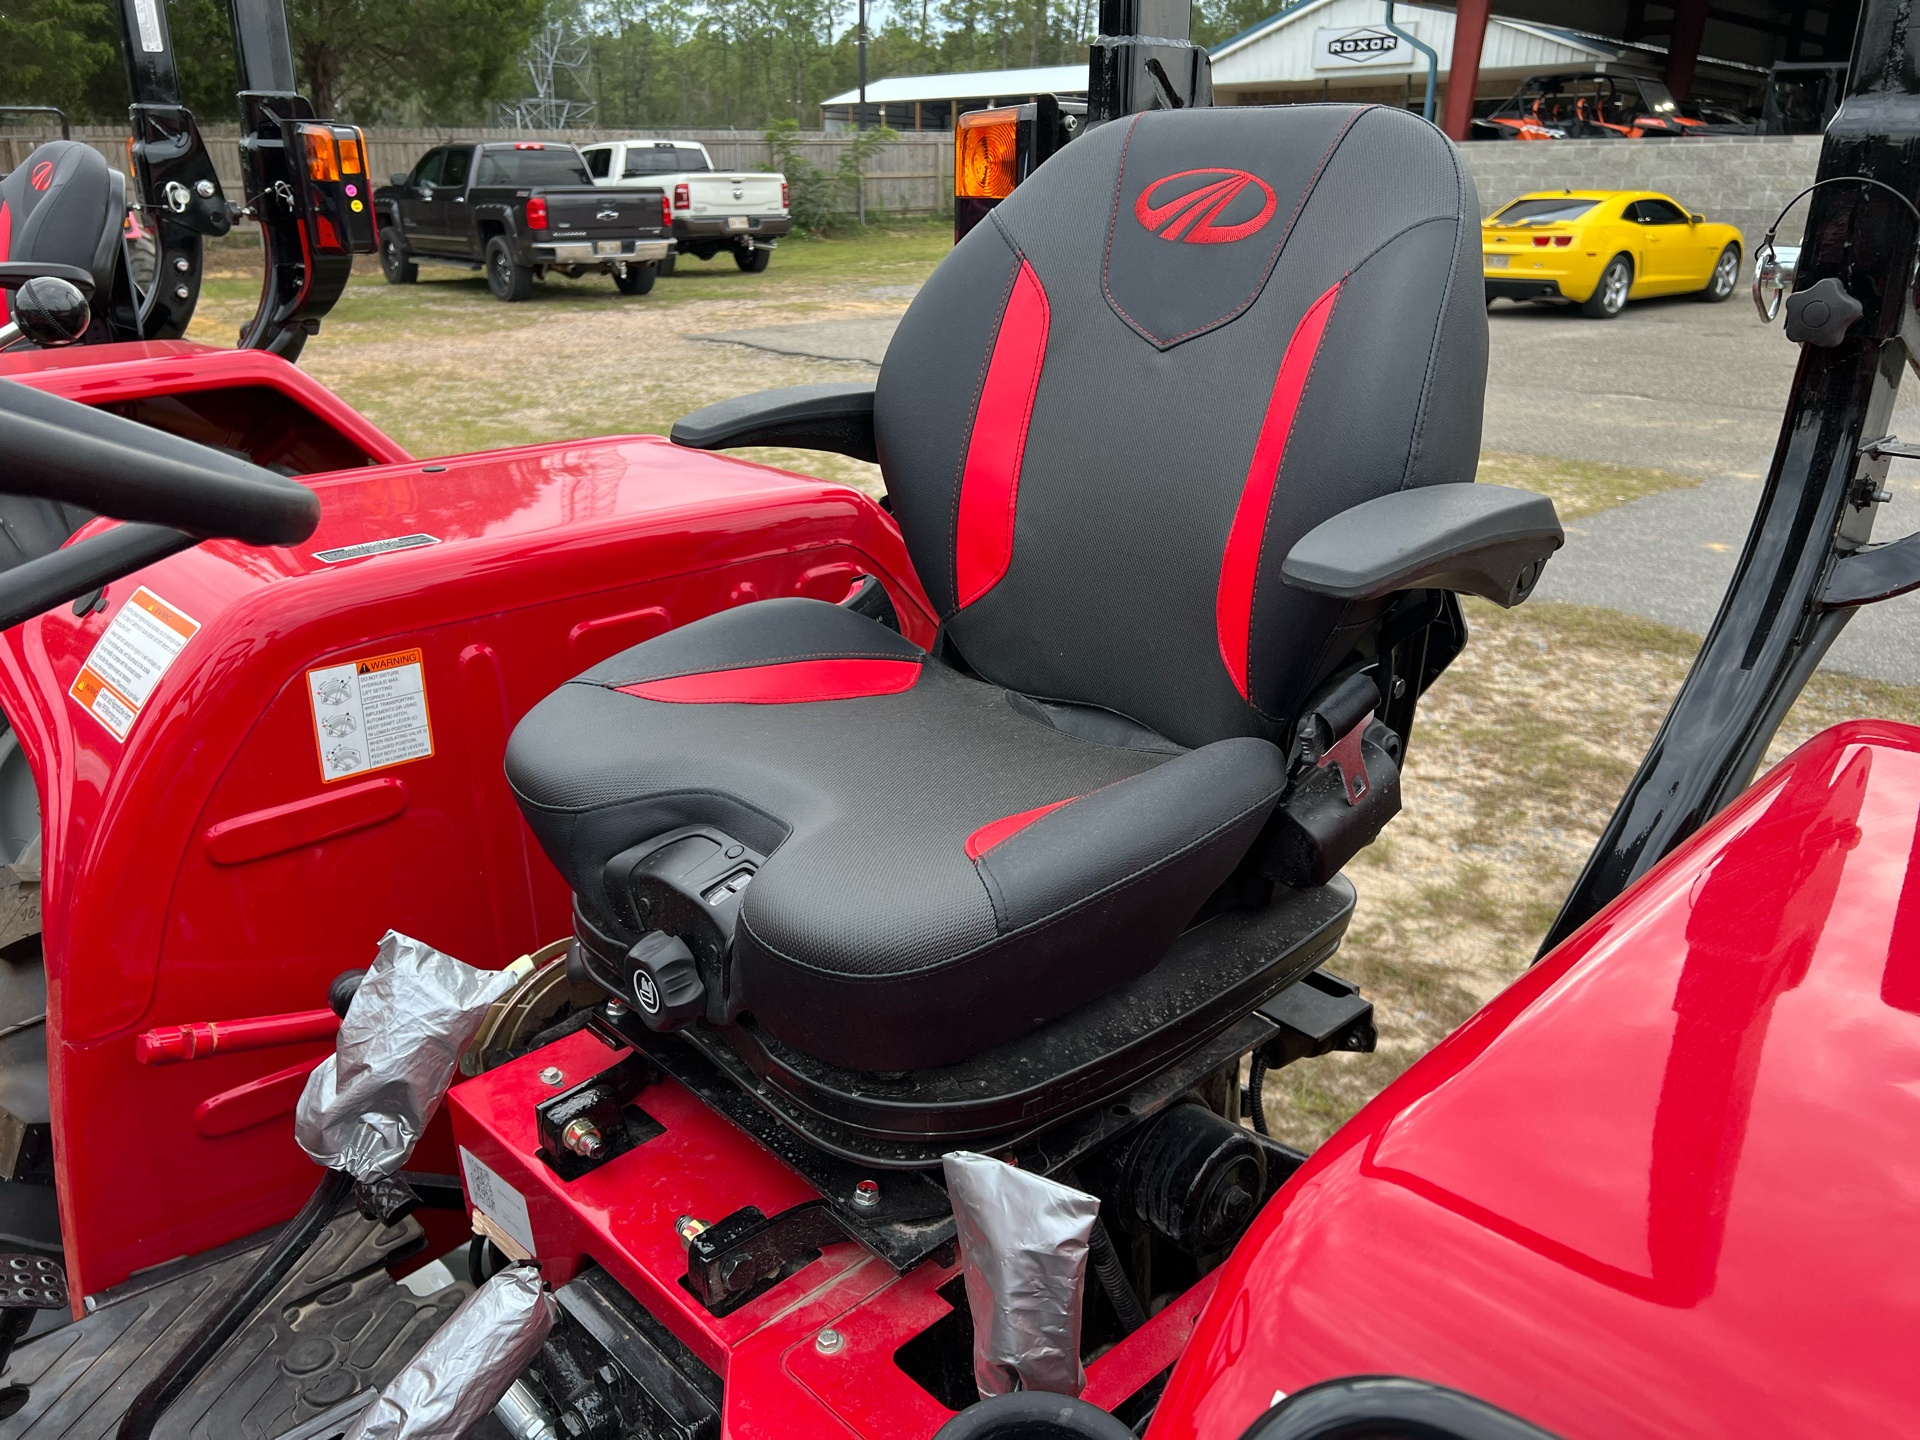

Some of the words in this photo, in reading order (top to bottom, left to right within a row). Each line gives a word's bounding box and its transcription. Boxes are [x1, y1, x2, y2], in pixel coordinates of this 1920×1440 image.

[1330, 37, 1396, 53] ROXOR
[371, 653, 416, 670] WARNING
[379, 670, 399, 678] DISTURB
[362, 679, 387, 689] HYDRAULIC
[373, 685, 392, 693] SETTING
[364, 694, 385, 702] STOPPER
[380, 695, 415, 707] TRANSPORTING
[366, 707, 394, 717] IMPLEMENTS
[367, 714, 393, 724] AUTOMATIC
[374, 728, 390, 736] LOWER
[391, 723, 412, 732] POSITION
[384, 733, 407, 742] ISOLATING
[408, 729, 422, 737] VALVE
[376, 743, 394, 751] CLOSED
[407, 742, 424, 750] LEVERS
[391, 753, 407, 761] LOWER
